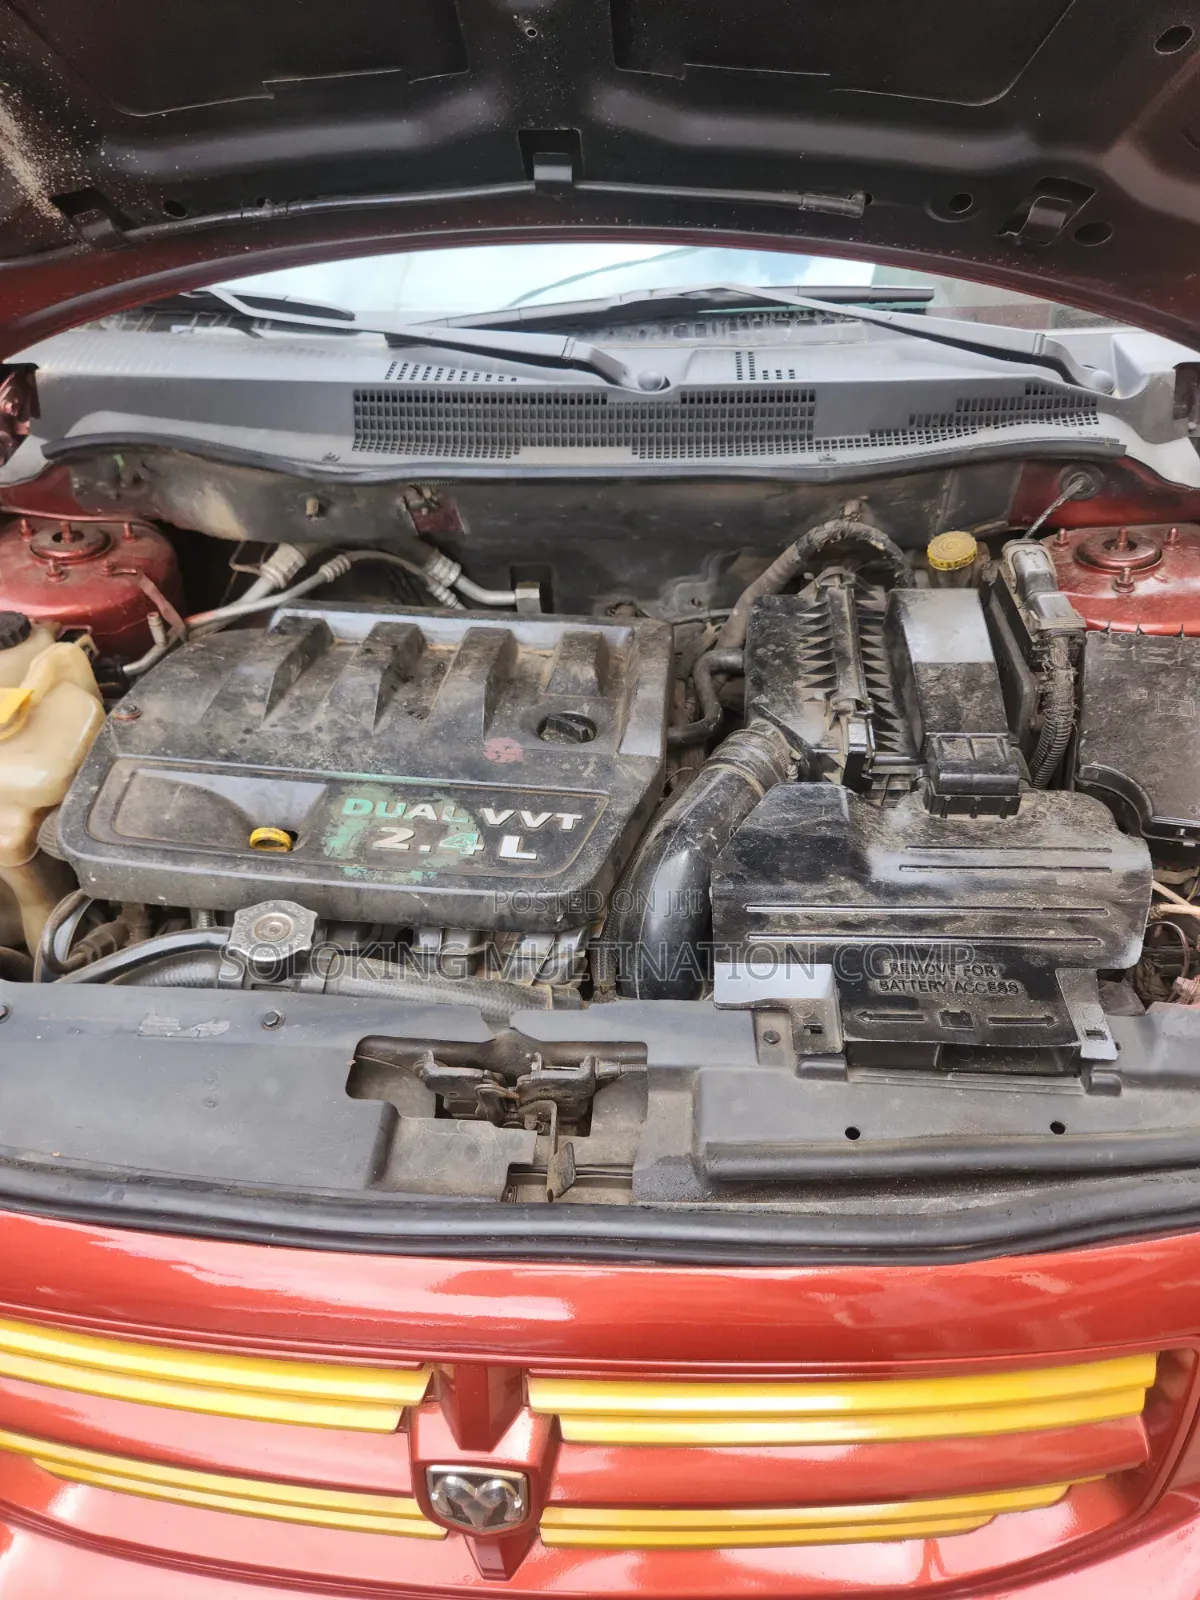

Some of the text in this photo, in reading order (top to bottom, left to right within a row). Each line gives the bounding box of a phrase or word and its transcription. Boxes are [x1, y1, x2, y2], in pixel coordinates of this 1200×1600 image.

[341, 798, 583, 831] DUAL VVT
[889, 962, 998, 977] REMOVE FOR
[879, 979, 1020, 996] BATTERY ACCESS
